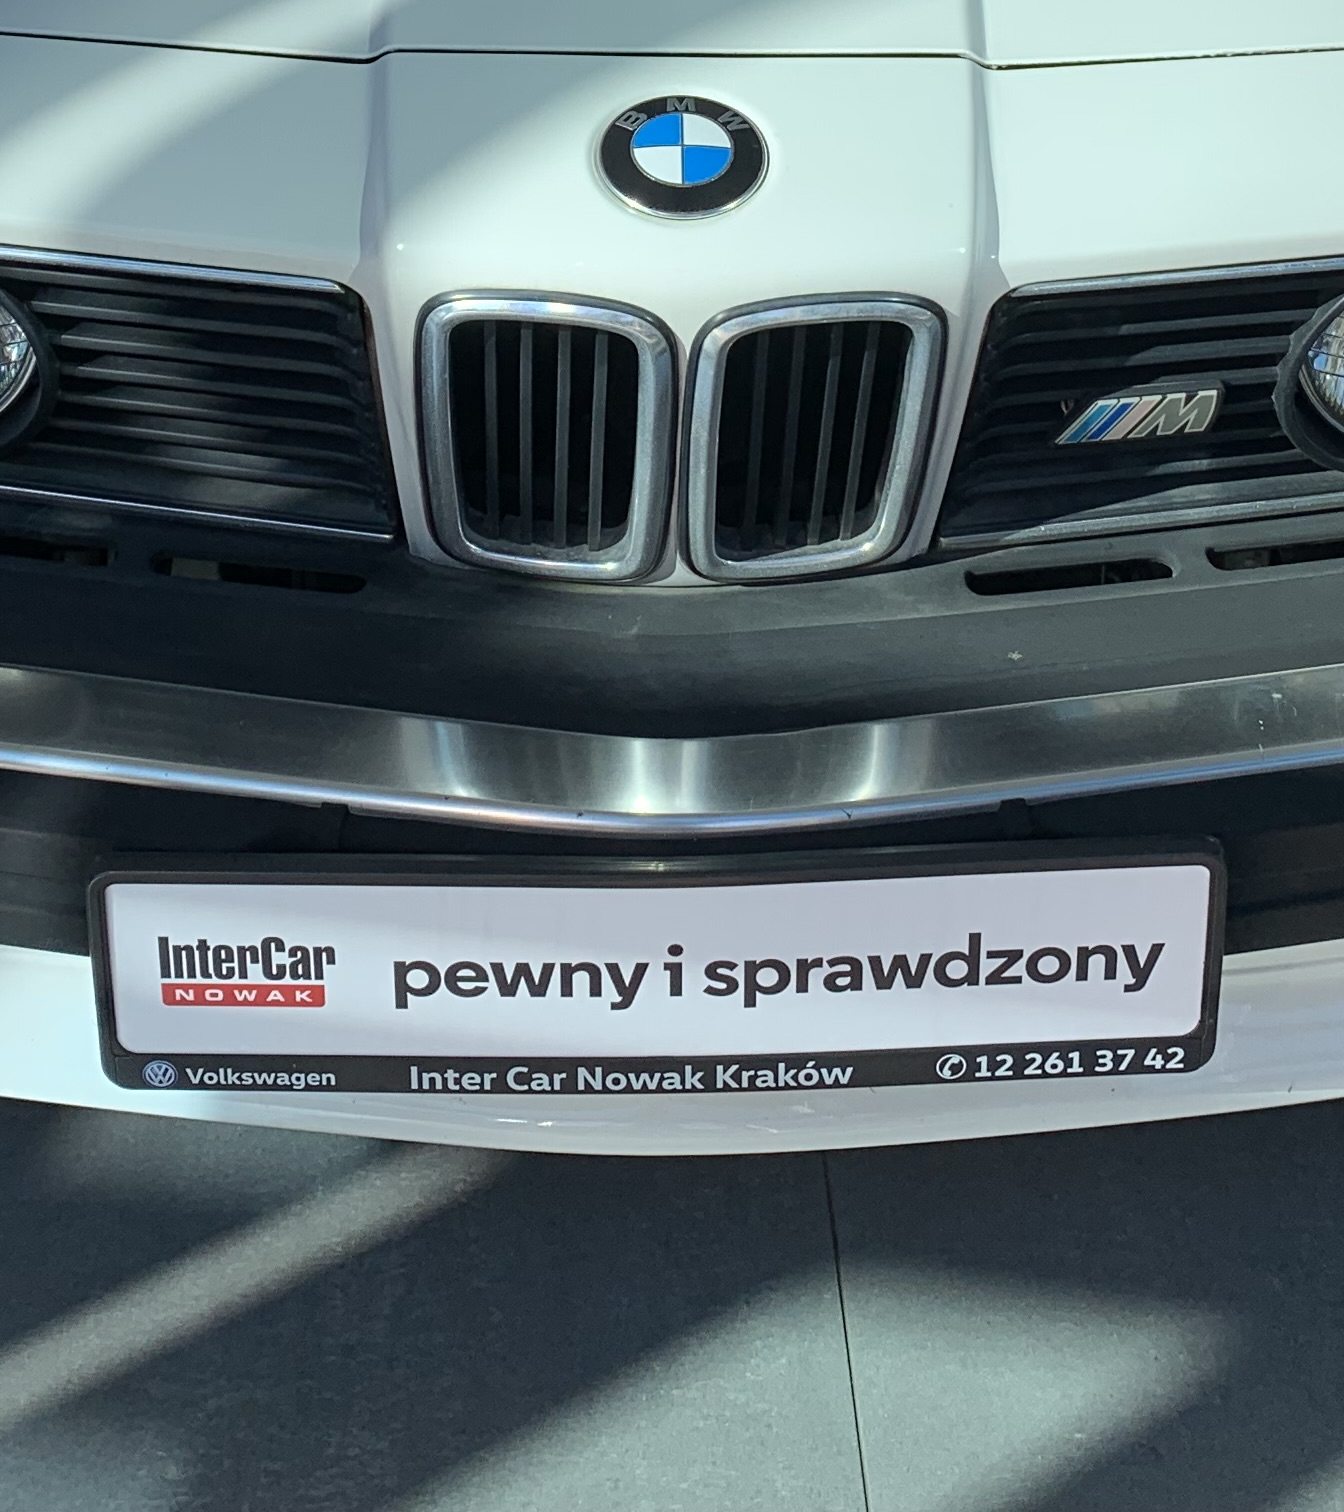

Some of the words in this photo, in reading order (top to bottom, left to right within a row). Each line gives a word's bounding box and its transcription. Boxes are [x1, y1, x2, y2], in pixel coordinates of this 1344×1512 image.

[615, 97, 751, 131] BMW
[157, 936, 336, 981] InterCar
[393, 960, 650, 1011] pewny
[663, 943, 685, 998] i
[702, 932, 1166, 1008] sprawdzony
[174, 988, 313, 1003] NOWAK
[185, 1068, 336, 1092] Volkswagen
[410, 1066, 496, 1092] Inter
[506, 1066, 567, 1092] Car
[577, 1062, 706, 1092] Nowak
[716, 1060, 854, 1091] Kraków
[974, 1054, 1014, 1078] 12
[1023, 1050, 1084, 1074] 261
[1094, 1049, 1133, 1072] 37
[1143, 1046, 1186, 1070] 42
